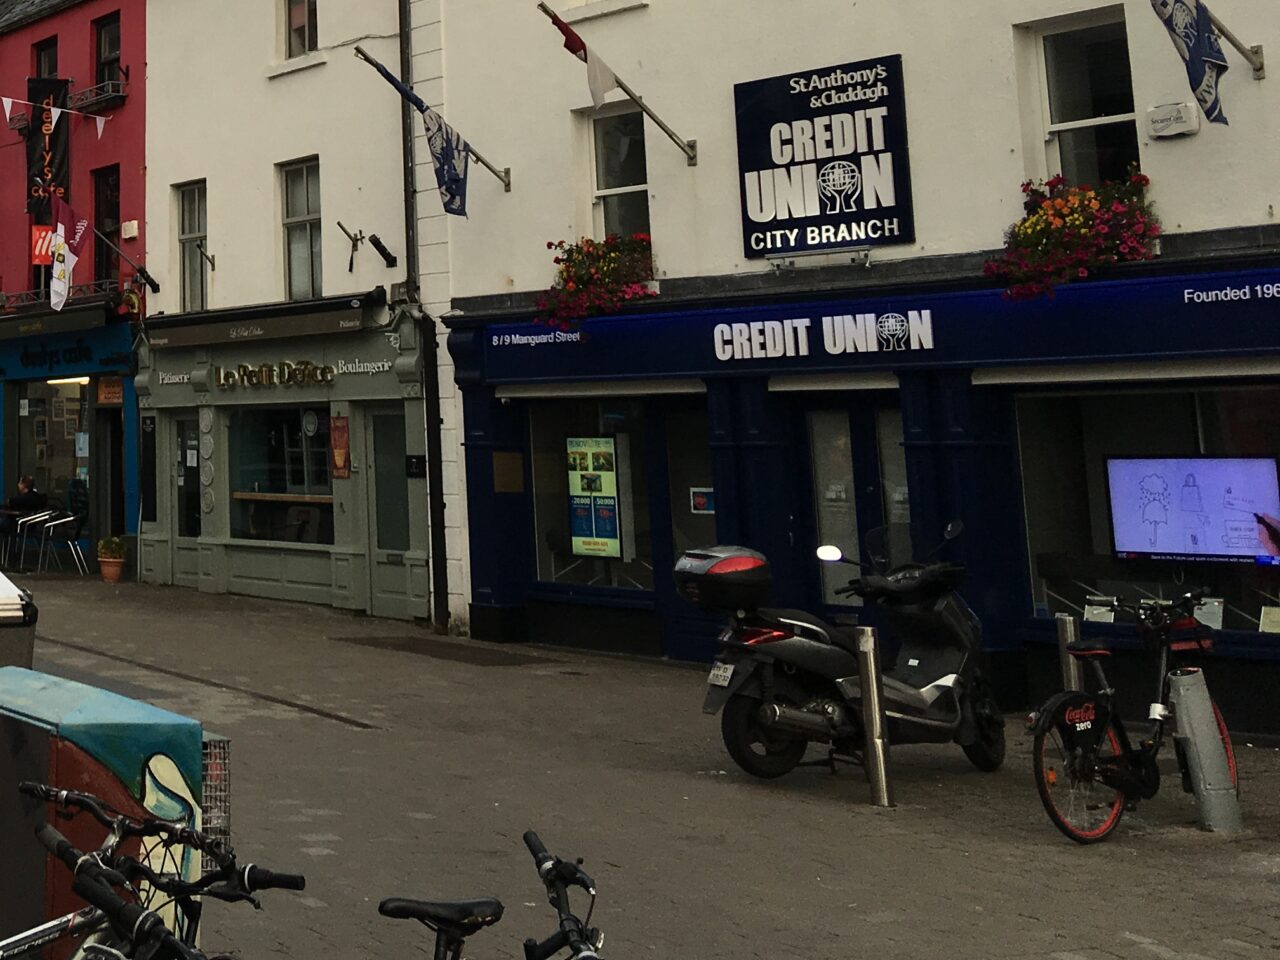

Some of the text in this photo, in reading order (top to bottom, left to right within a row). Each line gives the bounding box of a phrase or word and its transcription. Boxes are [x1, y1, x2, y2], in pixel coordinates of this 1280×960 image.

[789, 64, 888, 94] St Anthony's
[41, 93, 54, 179] deelys
[770, 106, 888, 165] CREDIT
[750, 218, 900, 250] CITY BRANCH
[1183, 285, 1250, 303] Founded
[555, 331, 581, 343] Street
[713, 318, 811, 361] CREDIT
[338, 358, 392, 377] Boulangerie
[1075, 721, 1092, 731] zero
